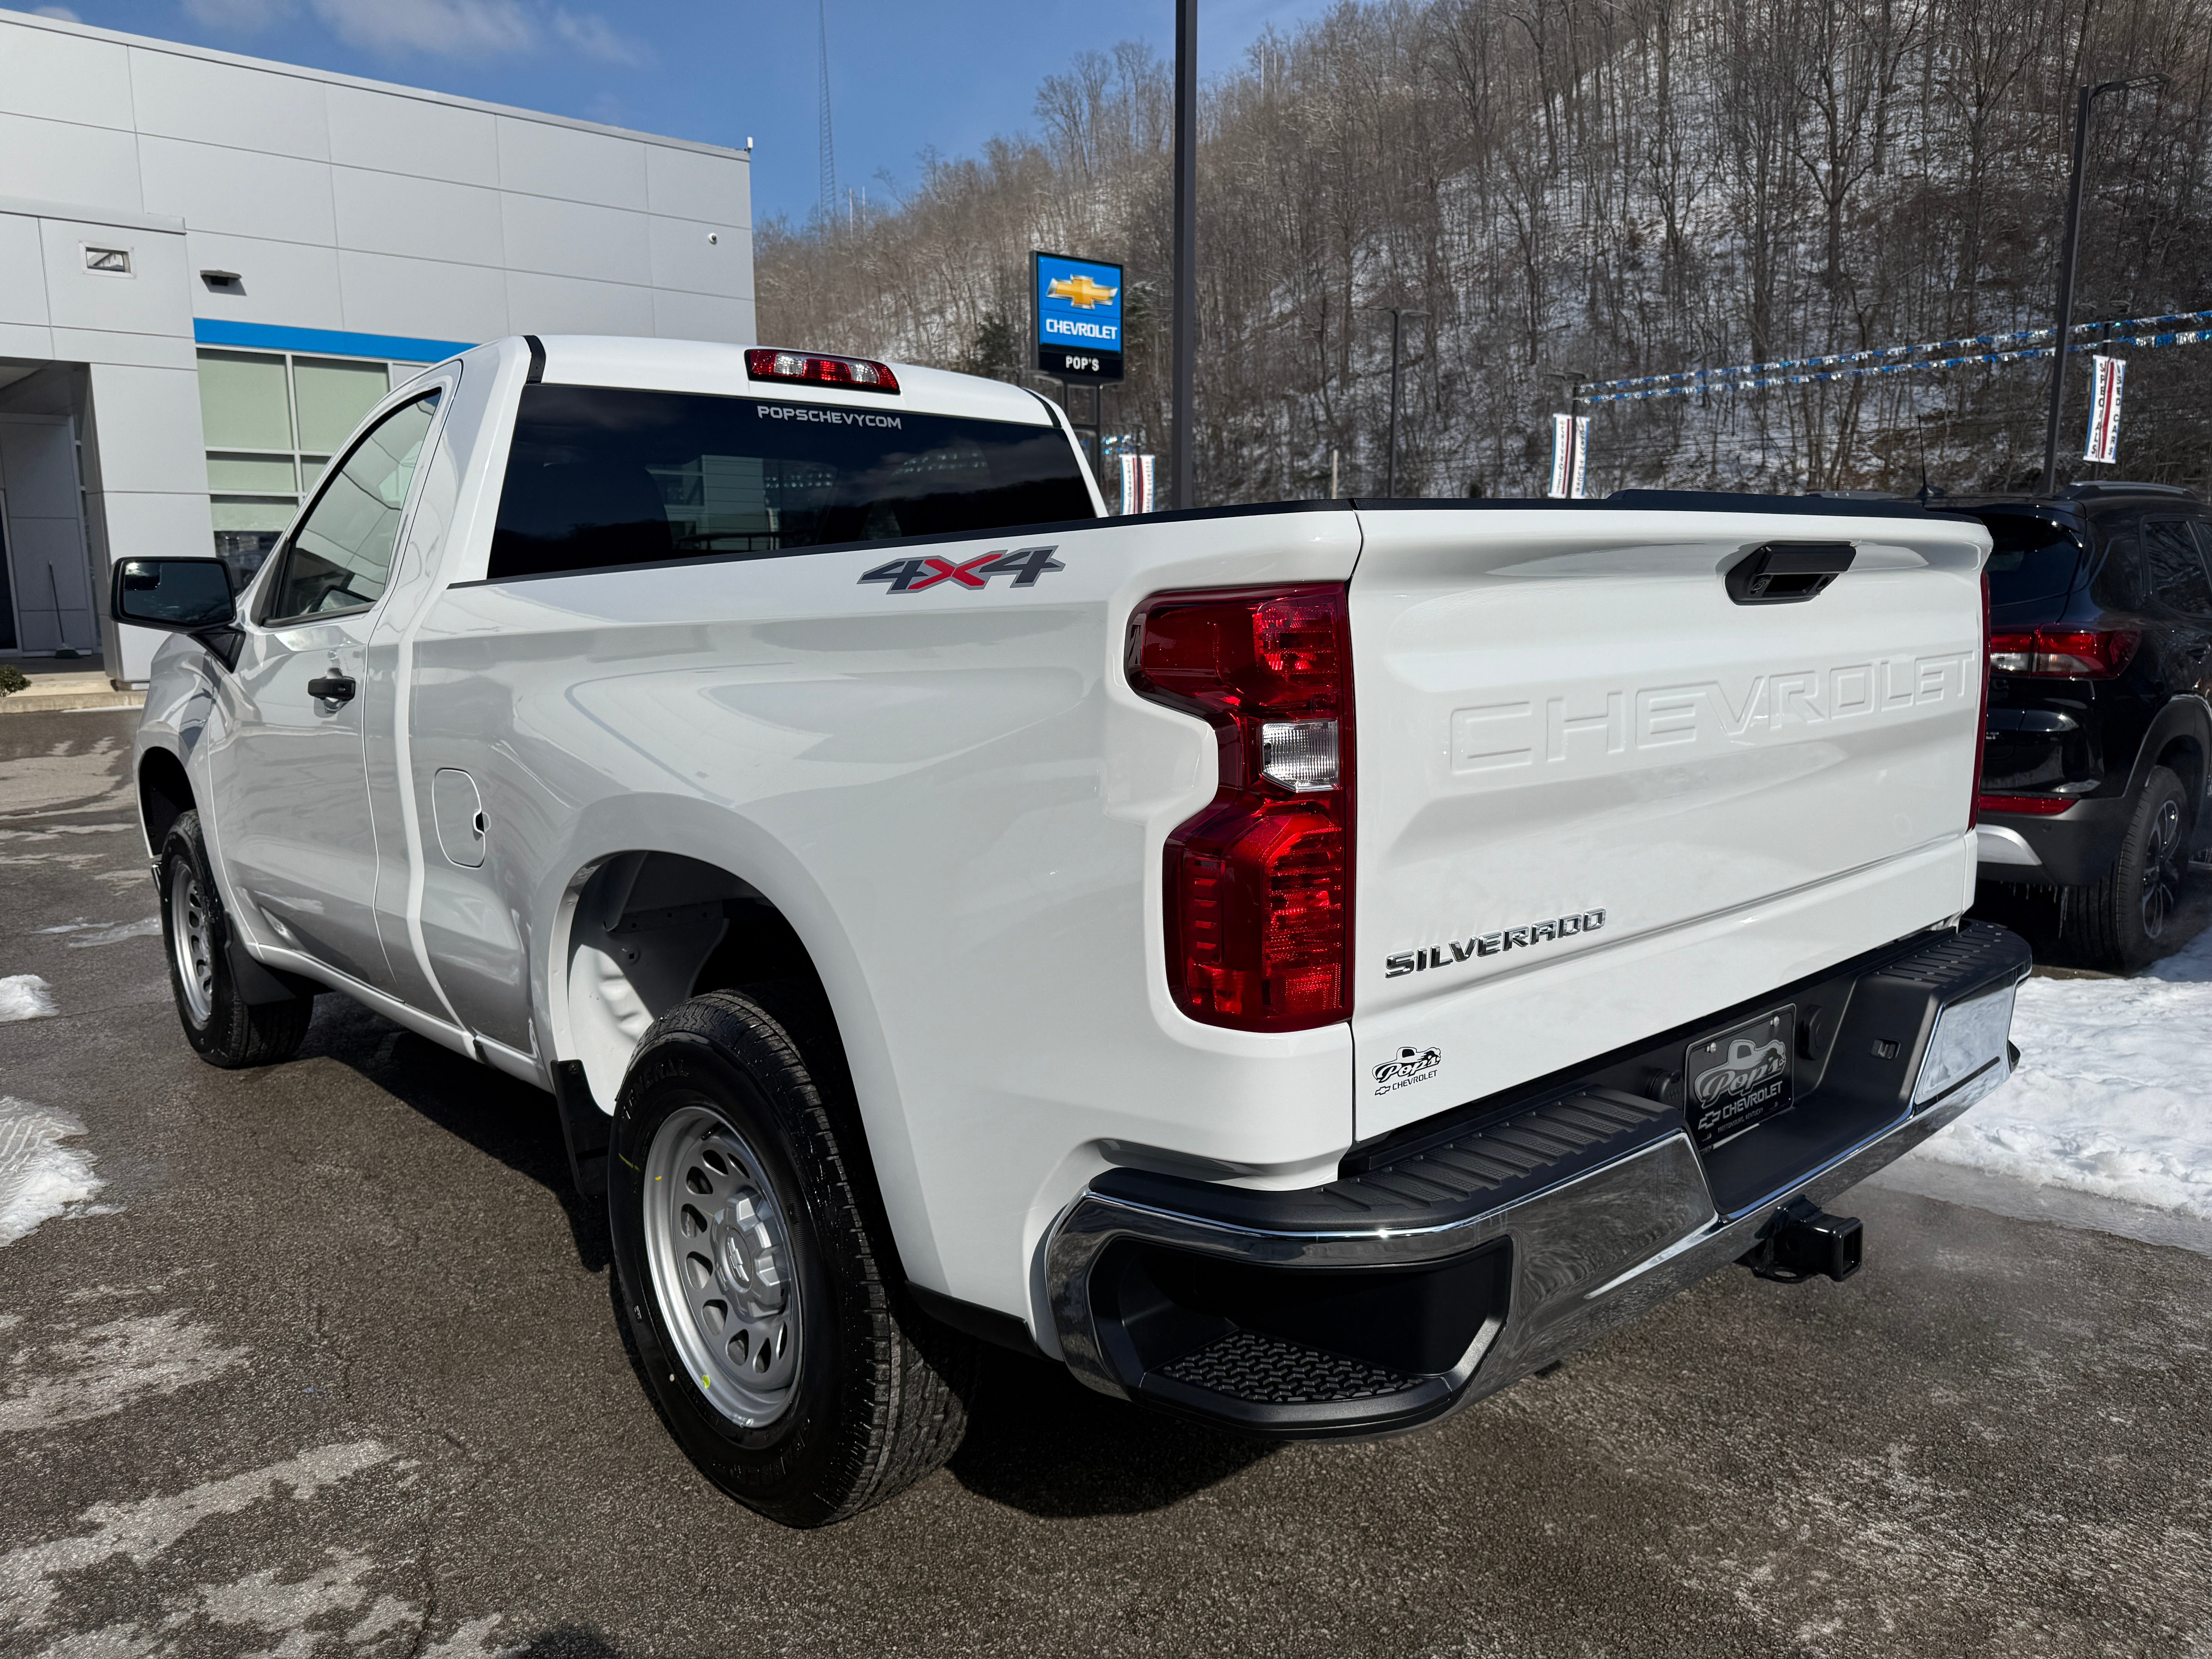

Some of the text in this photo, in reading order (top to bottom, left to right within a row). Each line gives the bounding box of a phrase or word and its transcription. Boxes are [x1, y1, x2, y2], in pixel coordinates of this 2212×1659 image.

[1046, 319, 1118, 339] CHEVROLET
[1066, 355, 1099, 371] POP'S
[2108, 414, 2119, 455] CARS
[1450, 651, 1976, 774] CHEVROLET
[1385, 907, 1606, 978] SILVERADO
[1393, 1070, 1437, 1090] CHEVROLET
[1723, 1081, 1783, 1119] CHEVROLET
